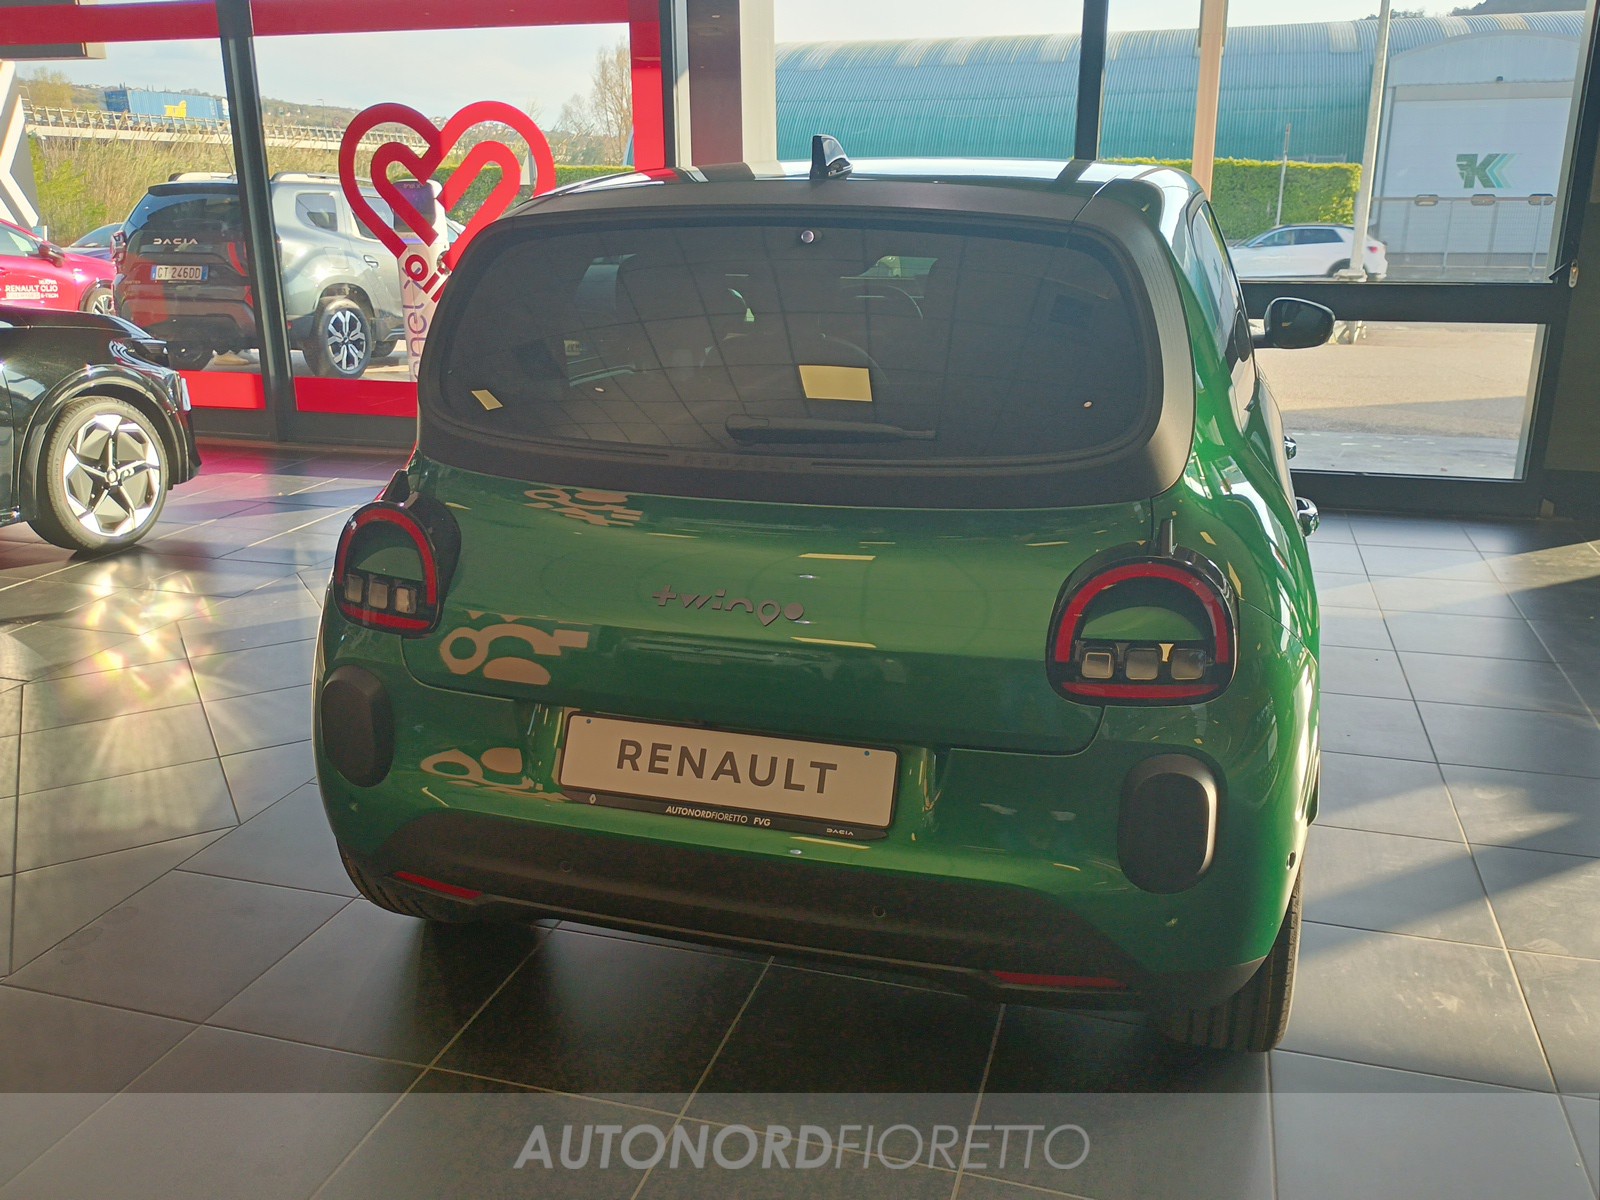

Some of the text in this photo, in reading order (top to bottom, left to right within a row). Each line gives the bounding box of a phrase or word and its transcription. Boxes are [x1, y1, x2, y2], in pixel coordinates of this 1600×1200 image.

[171, 267, 201, 279] 246DD
[5, 284, 40, 292] RENAULT
[652, 585, 804, 626] twingo
[616, 739, 838, 794] RENAULT
[665, 805, 771, 827] AUTONORDFIORETTO FVG
[826, 827, 854, 836] DACIA
